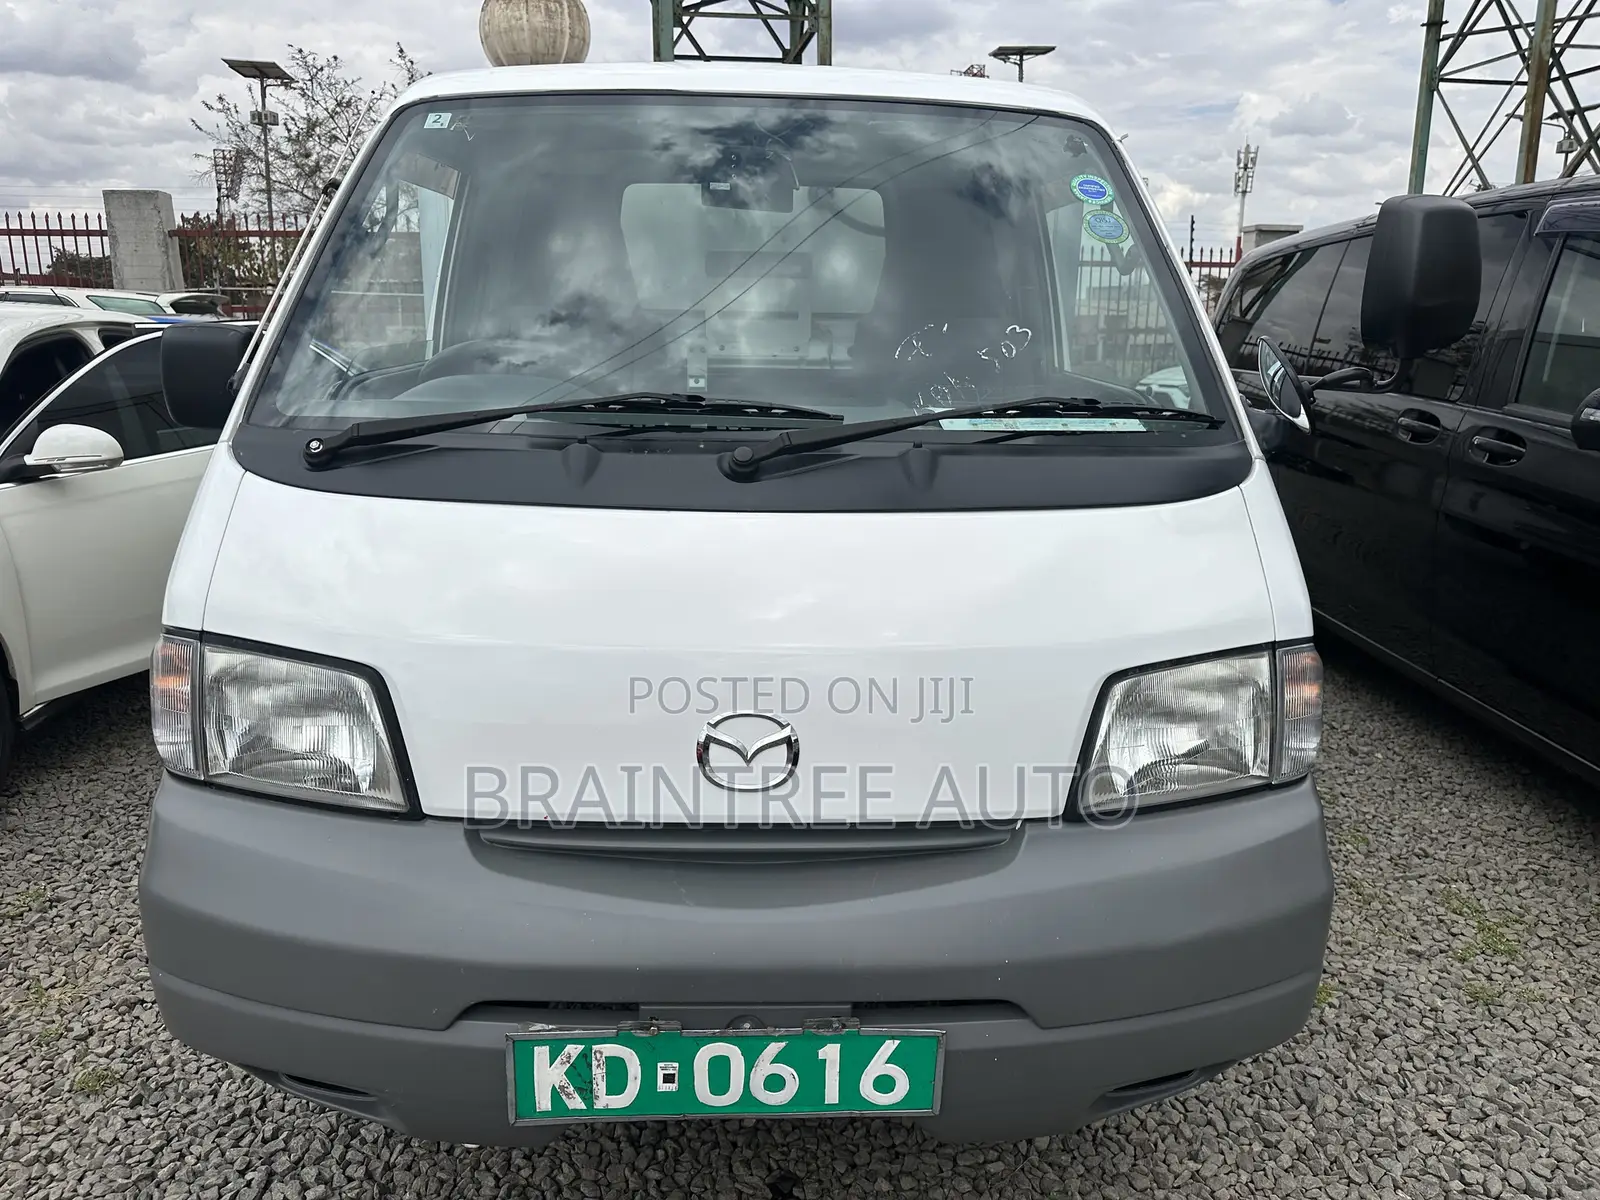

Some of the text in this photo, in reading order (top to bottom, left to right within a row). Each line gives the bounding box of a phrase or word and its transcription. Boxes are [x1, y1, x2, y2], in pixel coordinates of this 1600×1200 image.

[432, 114, 442, 124] 2
[533, 1039, 910, 1112] KD 0616
